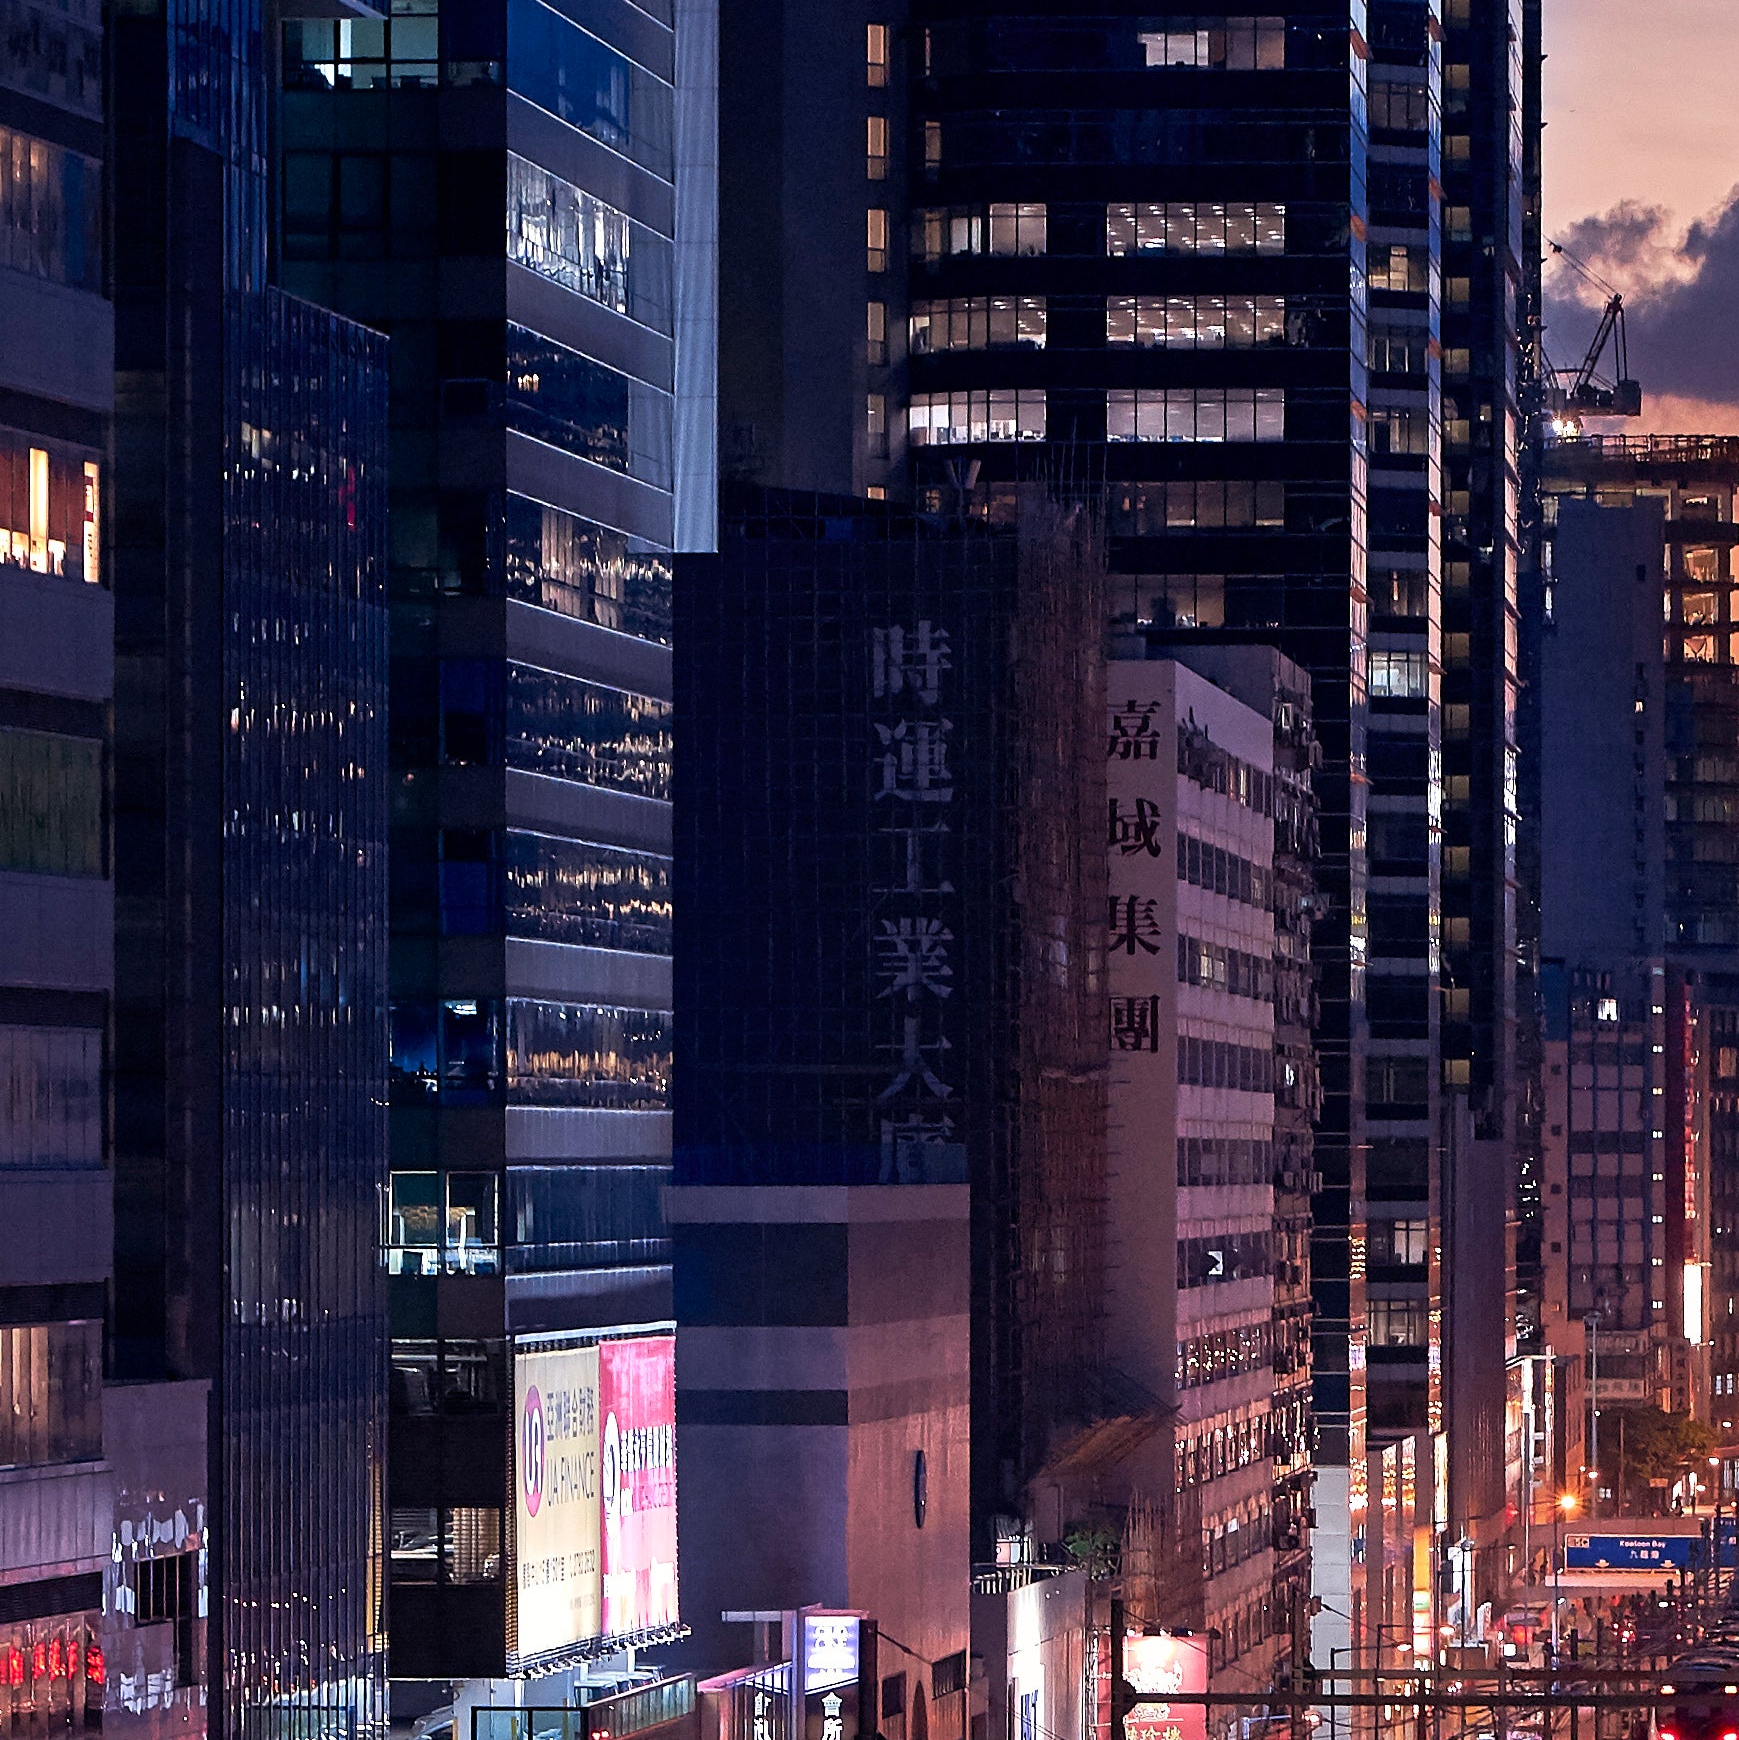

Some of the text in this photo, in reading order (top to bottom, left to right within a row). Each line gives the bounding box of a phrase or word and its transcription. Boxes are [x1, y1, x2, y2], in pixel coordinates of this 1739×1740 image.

[1107, 700, 1160, 1054] 嘉域集團
[561, 1450, 595, 1504] FINANCE
